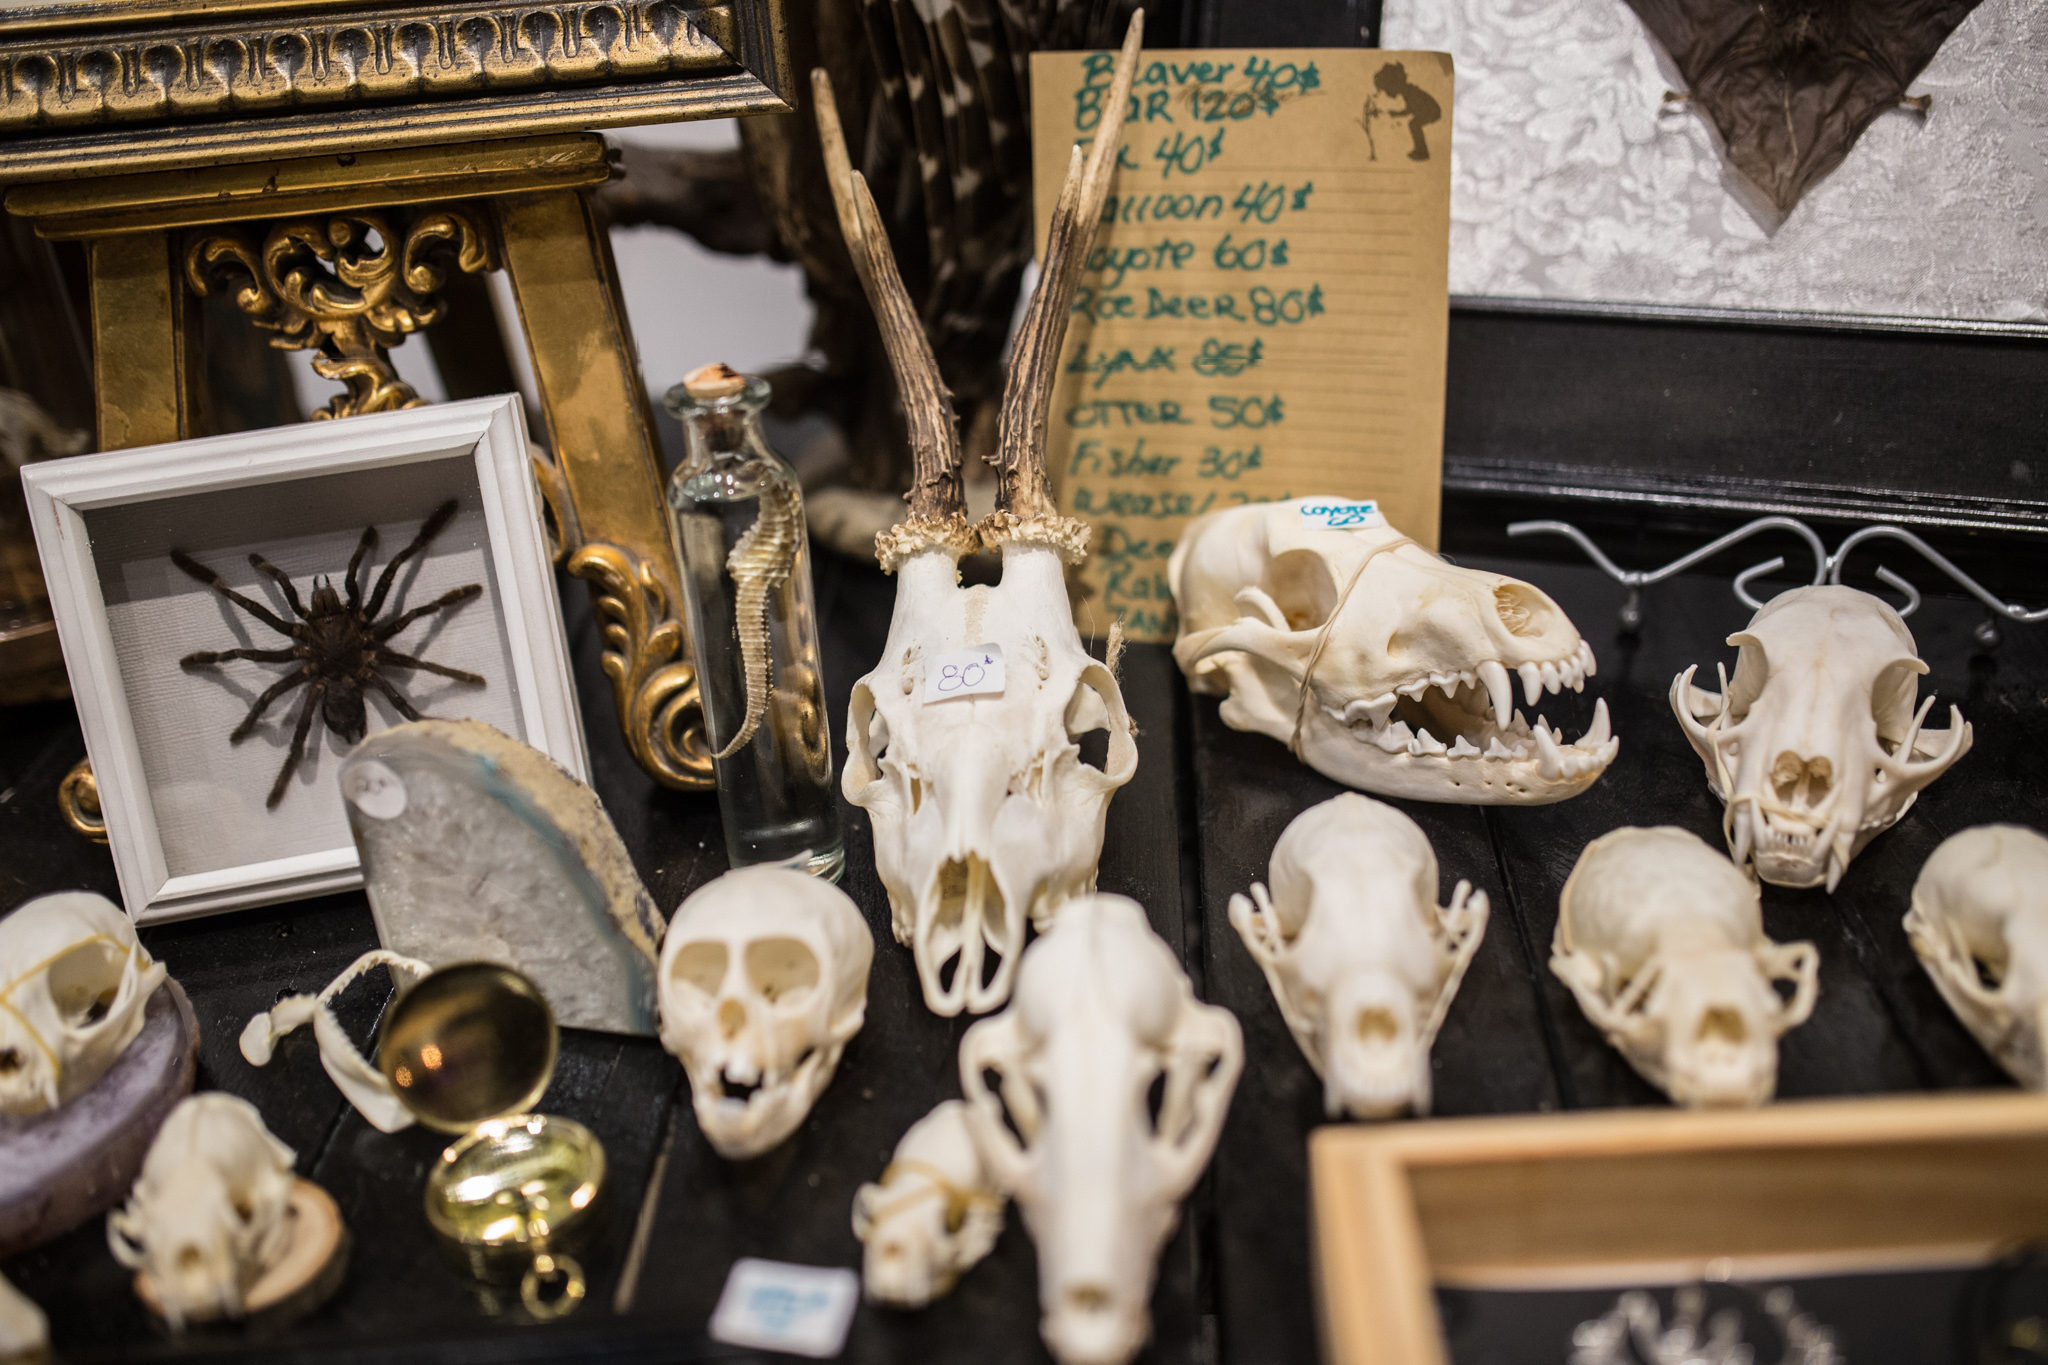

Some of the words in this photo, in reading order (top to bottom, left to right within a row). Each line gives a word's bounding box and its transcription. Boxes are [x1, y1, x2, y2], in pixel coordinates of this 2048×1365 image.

[1081, 52, 1235, 89] Baver
[1243, 55, 1320, 95] 40$
[1192, 81, 1279, 122] 120$
[1154, 127, 1225, 179] 40$
[1232, 181, 1314, 224] 40$
[1086, 237, 1195, 291] oyote
[1214, 233, 1289, 271] 60$
[1249, 282, 1325, 327] 80$
[1208, 394, 1285, 430] 50$
[1197, 444, 1263, 480] 30$
